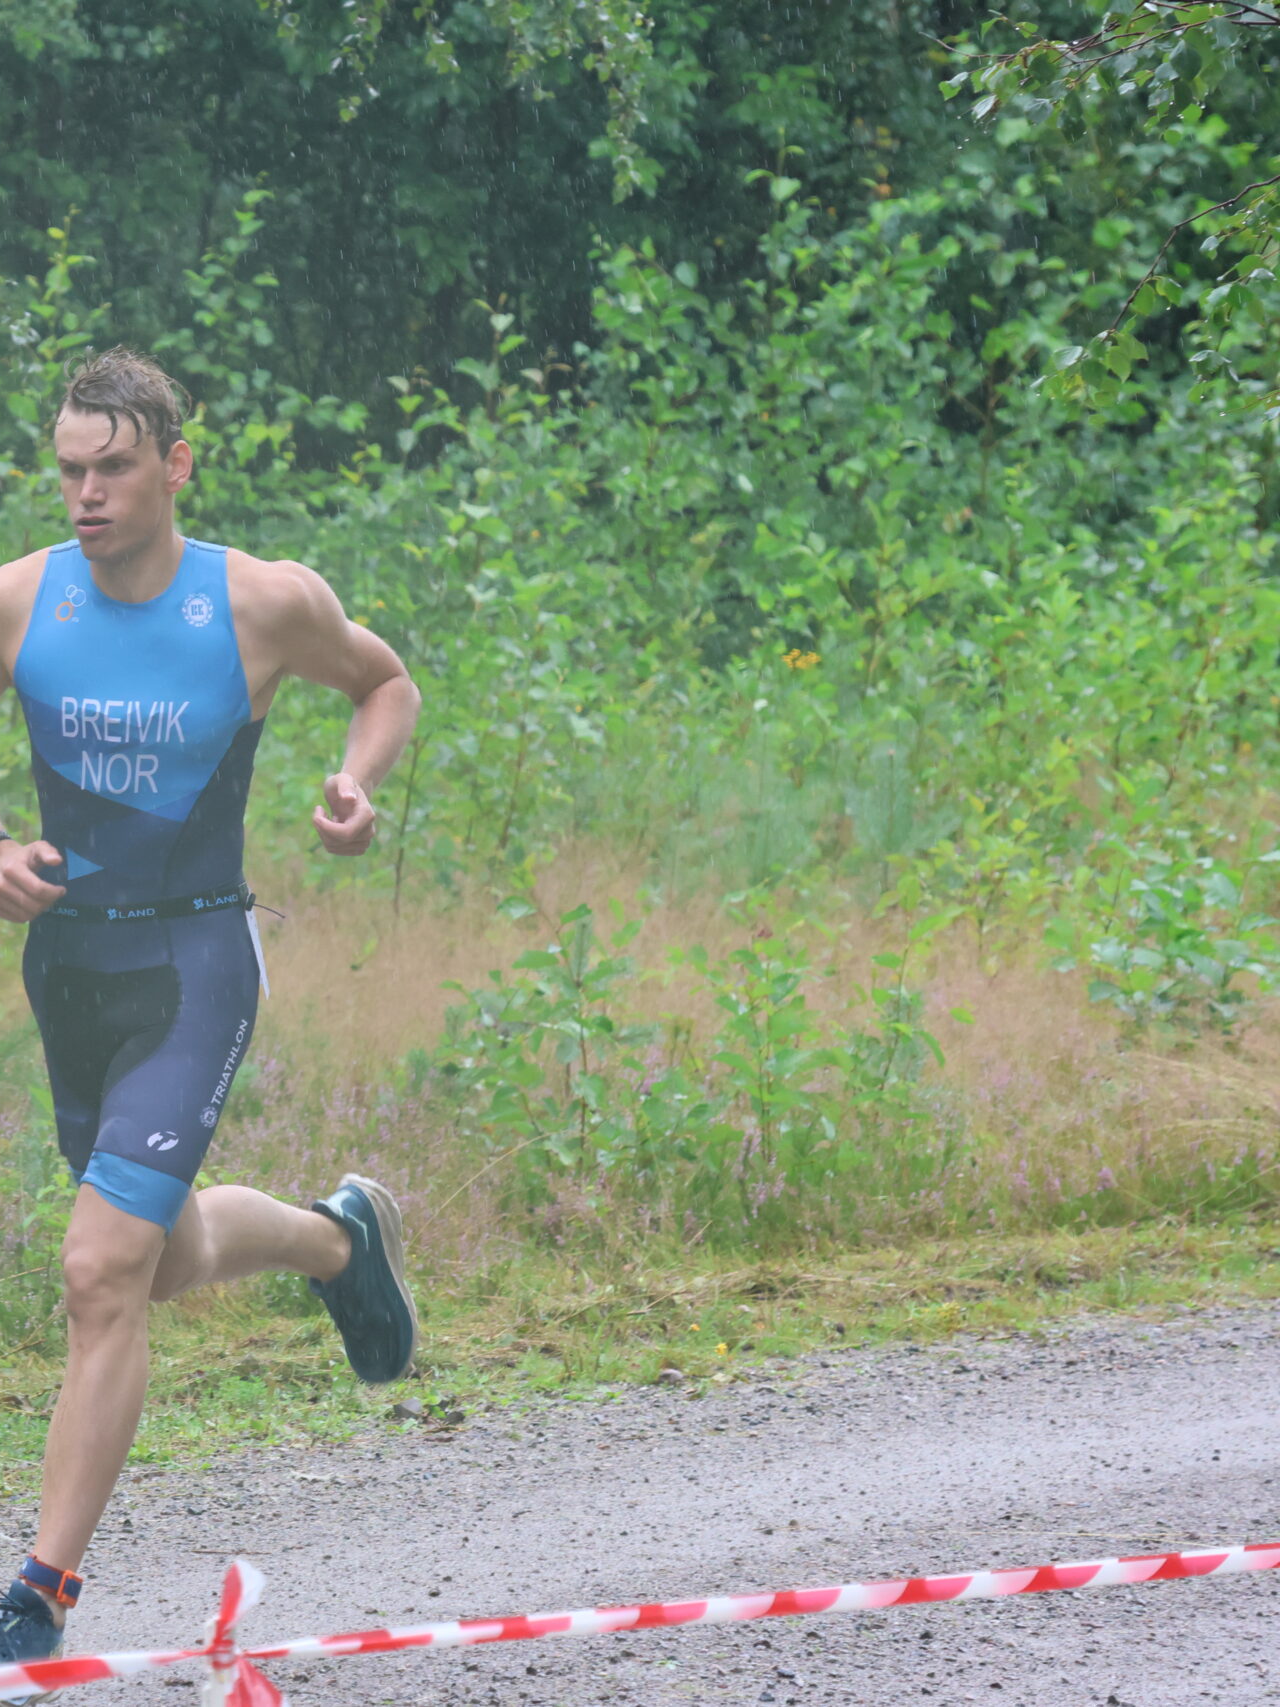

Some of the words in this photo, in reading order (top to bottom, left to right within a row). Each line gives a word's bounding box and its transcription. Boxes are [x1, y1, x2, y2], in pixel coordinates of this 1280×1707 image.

[61, 696, 191, 743] BREIVIK
[80, 750, 159, 794] NOR
[210, 1019, 248, 1105] TRIATHLON
